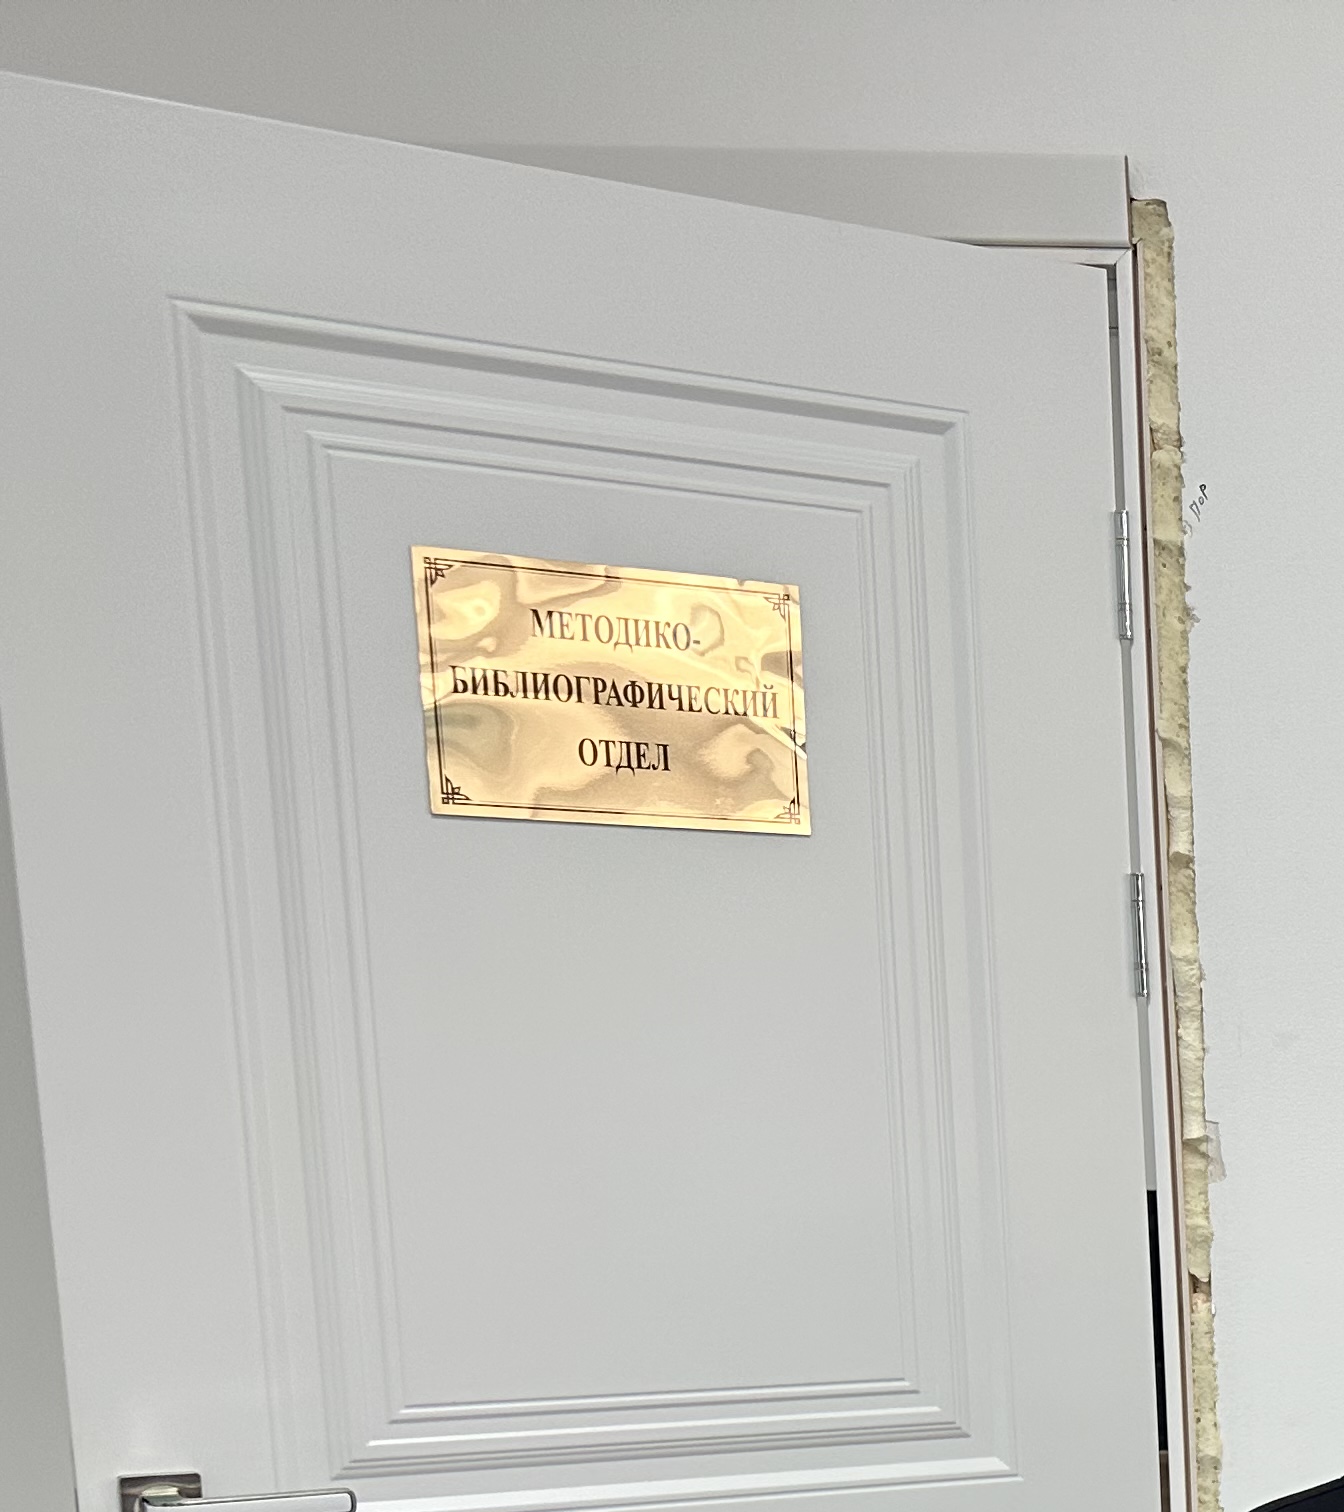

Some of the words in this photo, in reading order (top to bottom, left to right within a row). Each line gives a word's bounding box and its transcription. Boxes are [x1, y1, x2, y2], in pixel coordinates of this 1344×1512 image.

[530, 607, 701, 653] МЕТОДИКО-
[448, 665, 780, 719] БИБЛИОГРАФИЧЕСКИЙ
[578, 738, 671, 776] ОТДЕЛ
